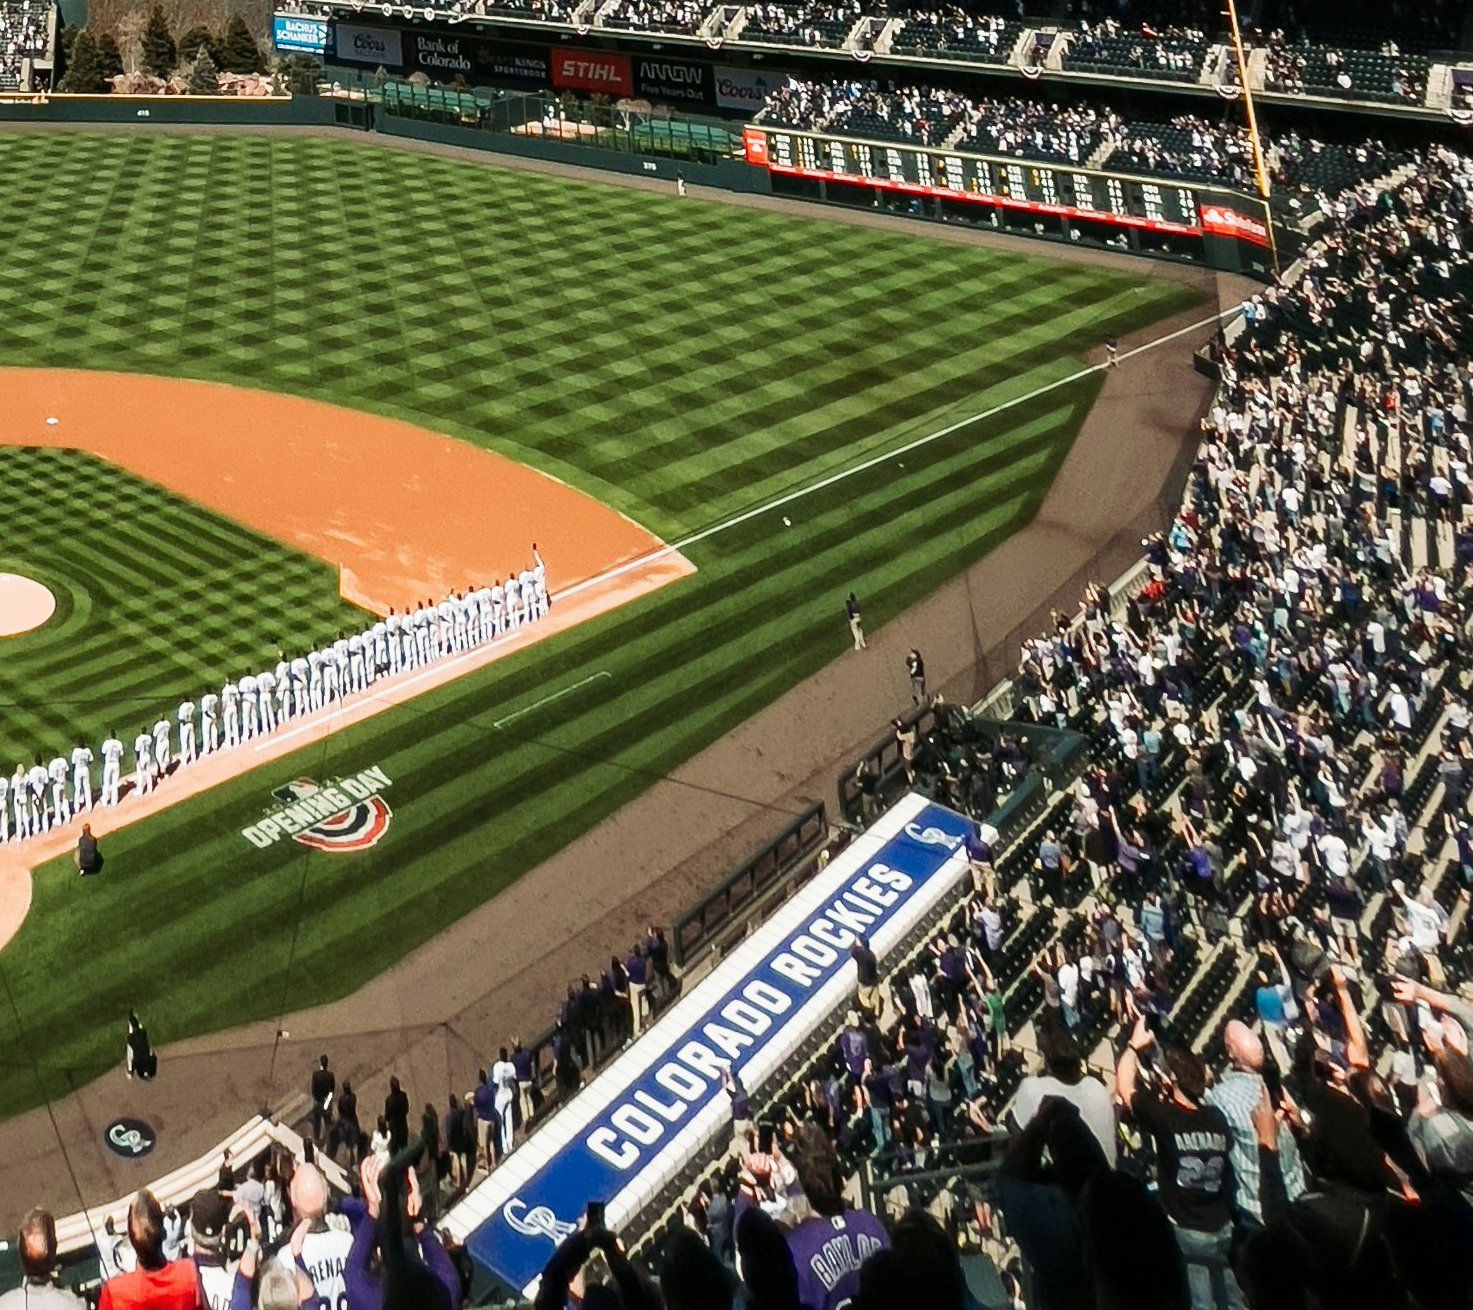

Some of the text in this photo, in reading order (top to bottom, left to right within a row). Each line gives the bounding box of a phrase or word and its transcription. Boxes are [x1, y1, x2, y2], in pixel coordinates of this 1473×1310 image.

[354, 34, 386, 52] Coors
[418, 37, 459, 54] Bank of
[418, 53, 471, 70] Colorado
[562, 60, 622, 81] STIHL
[641, 84, 704, 100] Five Years Out
[717, 78, 763, 100] Coors
[241, 765, 394, 849] OPENING DAY
[585, 863, 913, 1170] COLORADO ROCKIES
